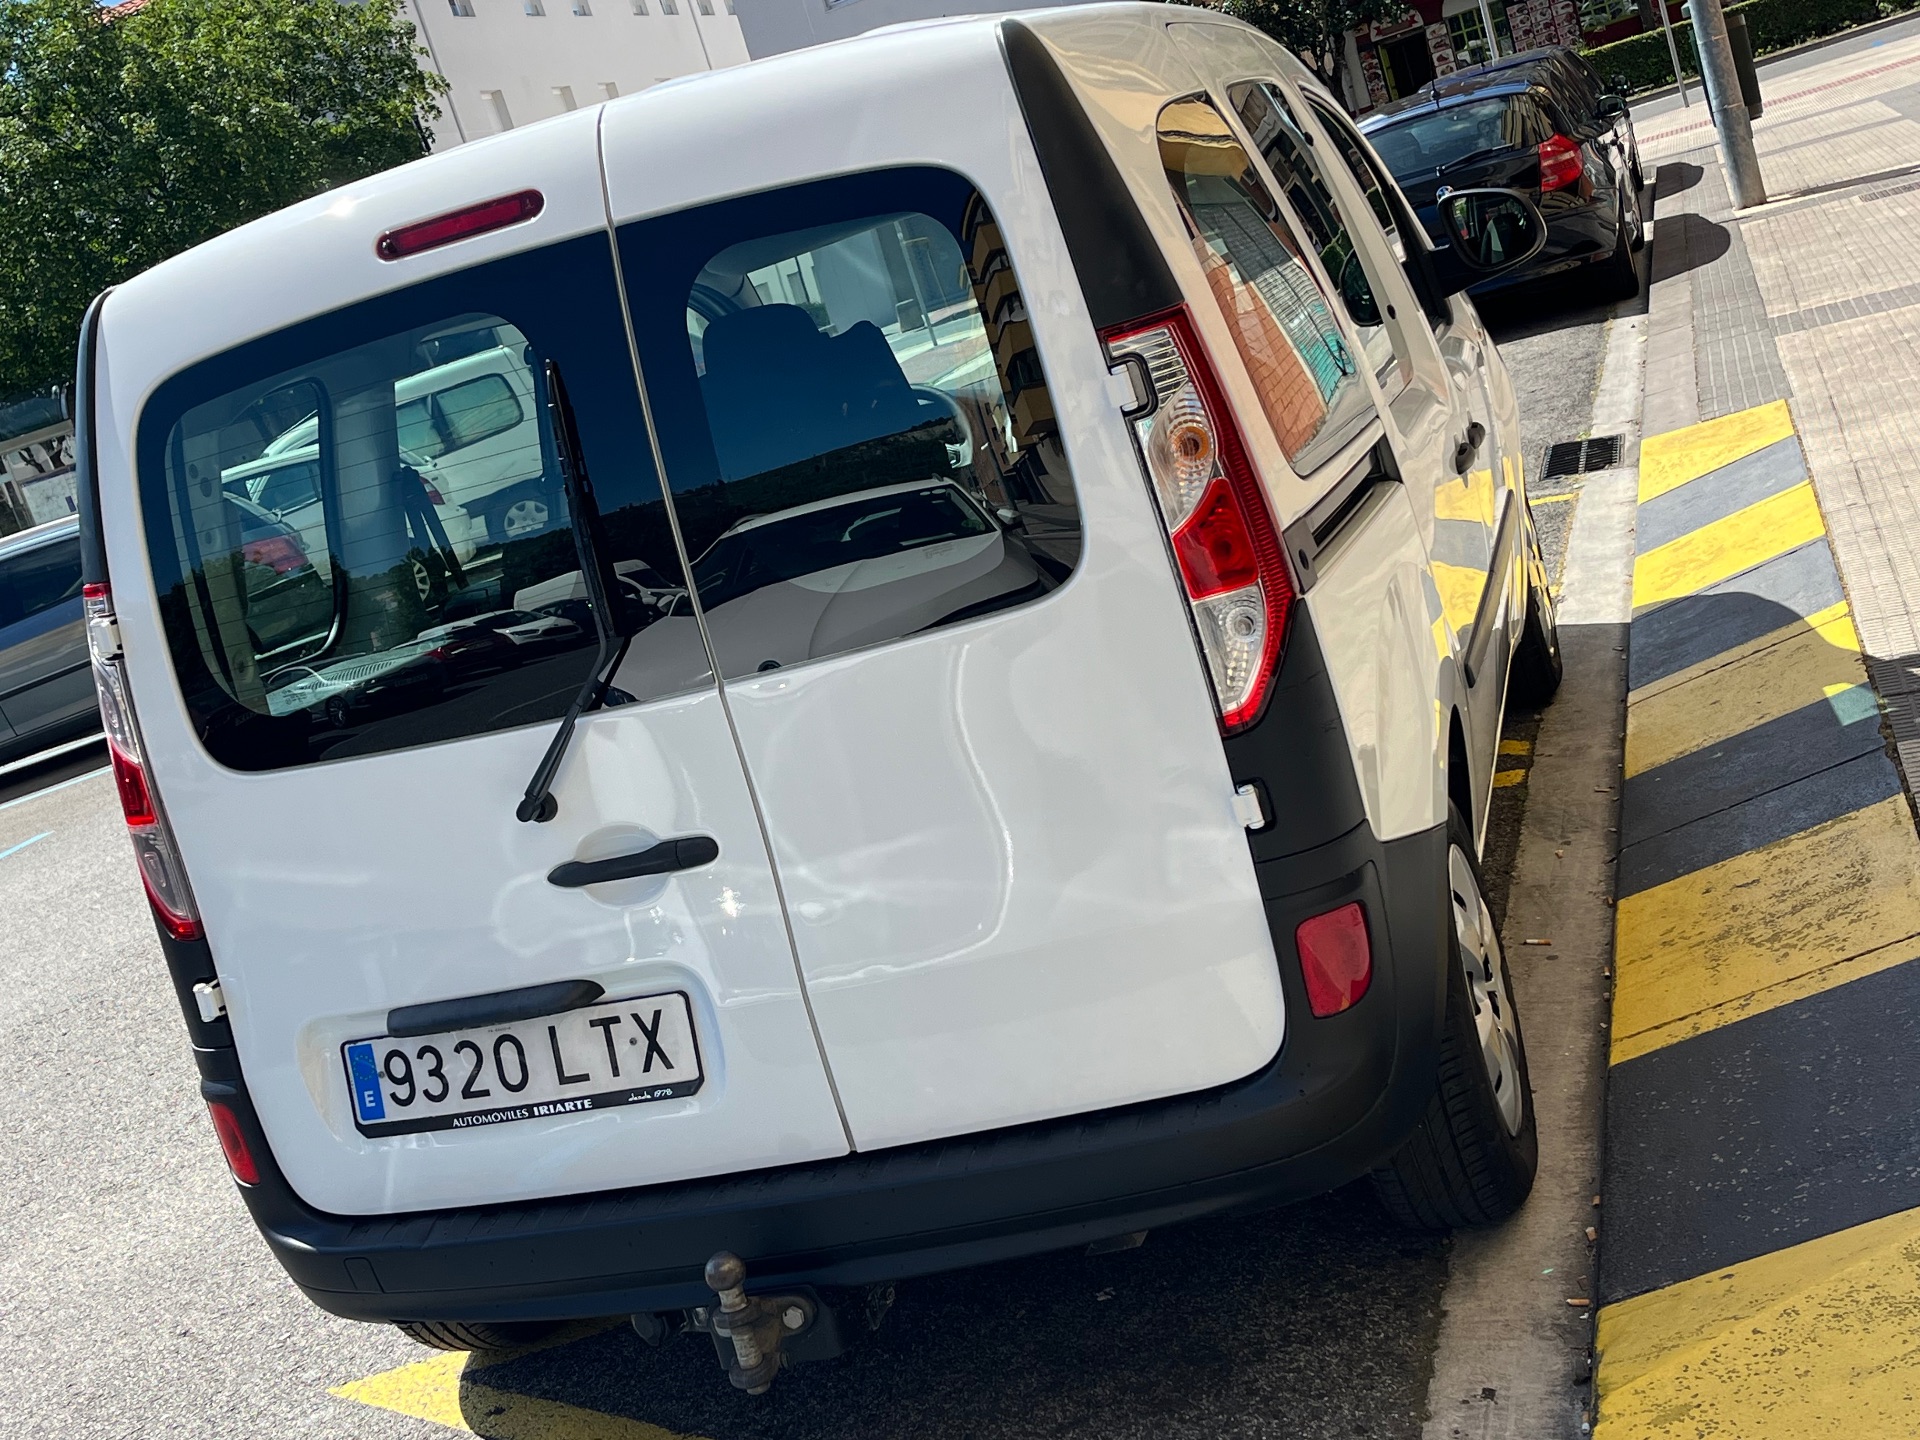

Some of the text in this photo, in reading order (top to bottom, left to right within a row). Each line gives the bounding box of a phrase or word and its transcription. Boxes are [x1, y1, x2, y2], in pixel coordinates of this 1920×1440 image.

[383, 1009, 675, 1106] 9320 LTX
[363, 1090, 376, 1107] E
[533, 1098, 593, 1116] IRIARTE
